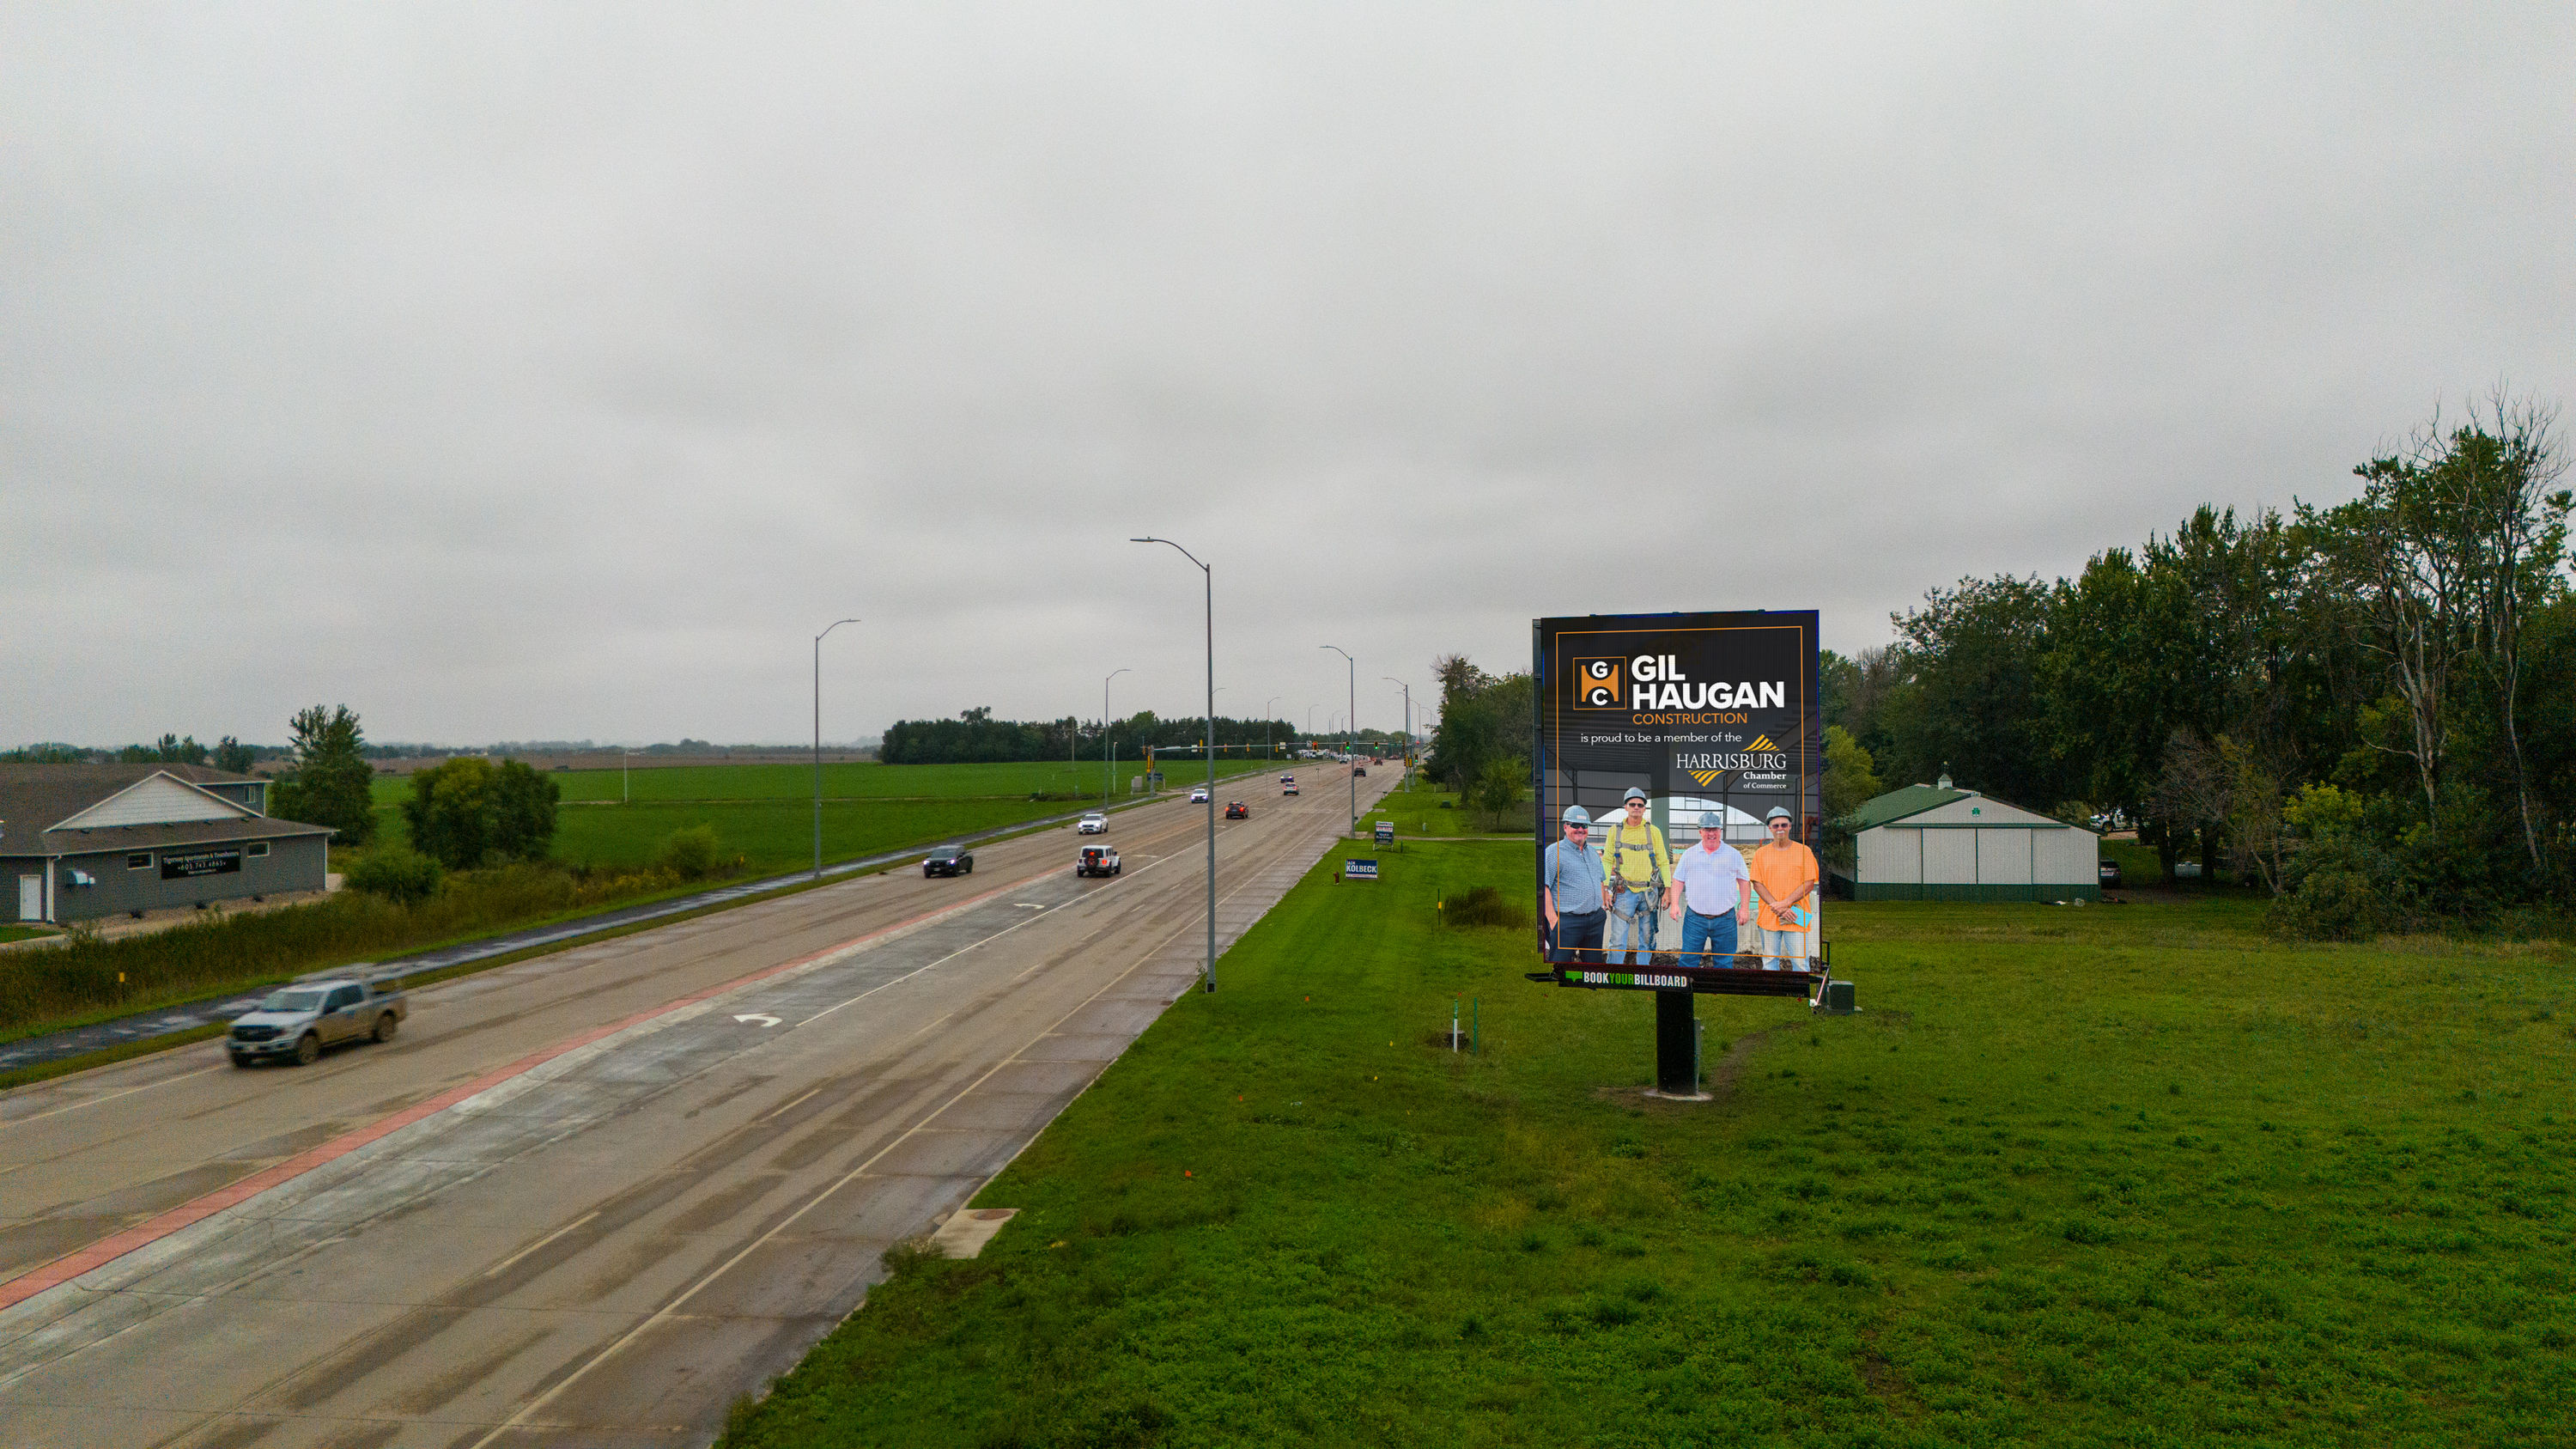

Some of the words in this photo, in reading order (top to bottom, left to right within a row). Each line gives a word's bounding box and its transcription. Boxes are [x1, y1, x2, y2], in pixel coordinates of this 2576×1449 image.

[1591, 661, 1608, 679] G
[1631, 654, 1686, 682] GIL
[1591, 688, 1608, 706] C
[1632, 681, 1785, 710] HAUGAN
[1632, 712, 1748, 726] CONSTRUCTION
[1580, 733, 1589, 743] is
[1591, 733, 1622, 746] proud
[1625, 734, 1635, 743] to
[1637, 733, 1652, 743] be
[1663, 732, 1709, 743] member
[1710, 732, 1722, 742] of
[1724, 732, 1742, 742] the
[1676, 753, 1787, 770] HARRISBURG
[1743, 771, 1787, 780] Chamber
[1346, 864, 1376, 873] KOLBECK
[1583, 971, 1687, 987] BOOKYOURBILLBOARD
